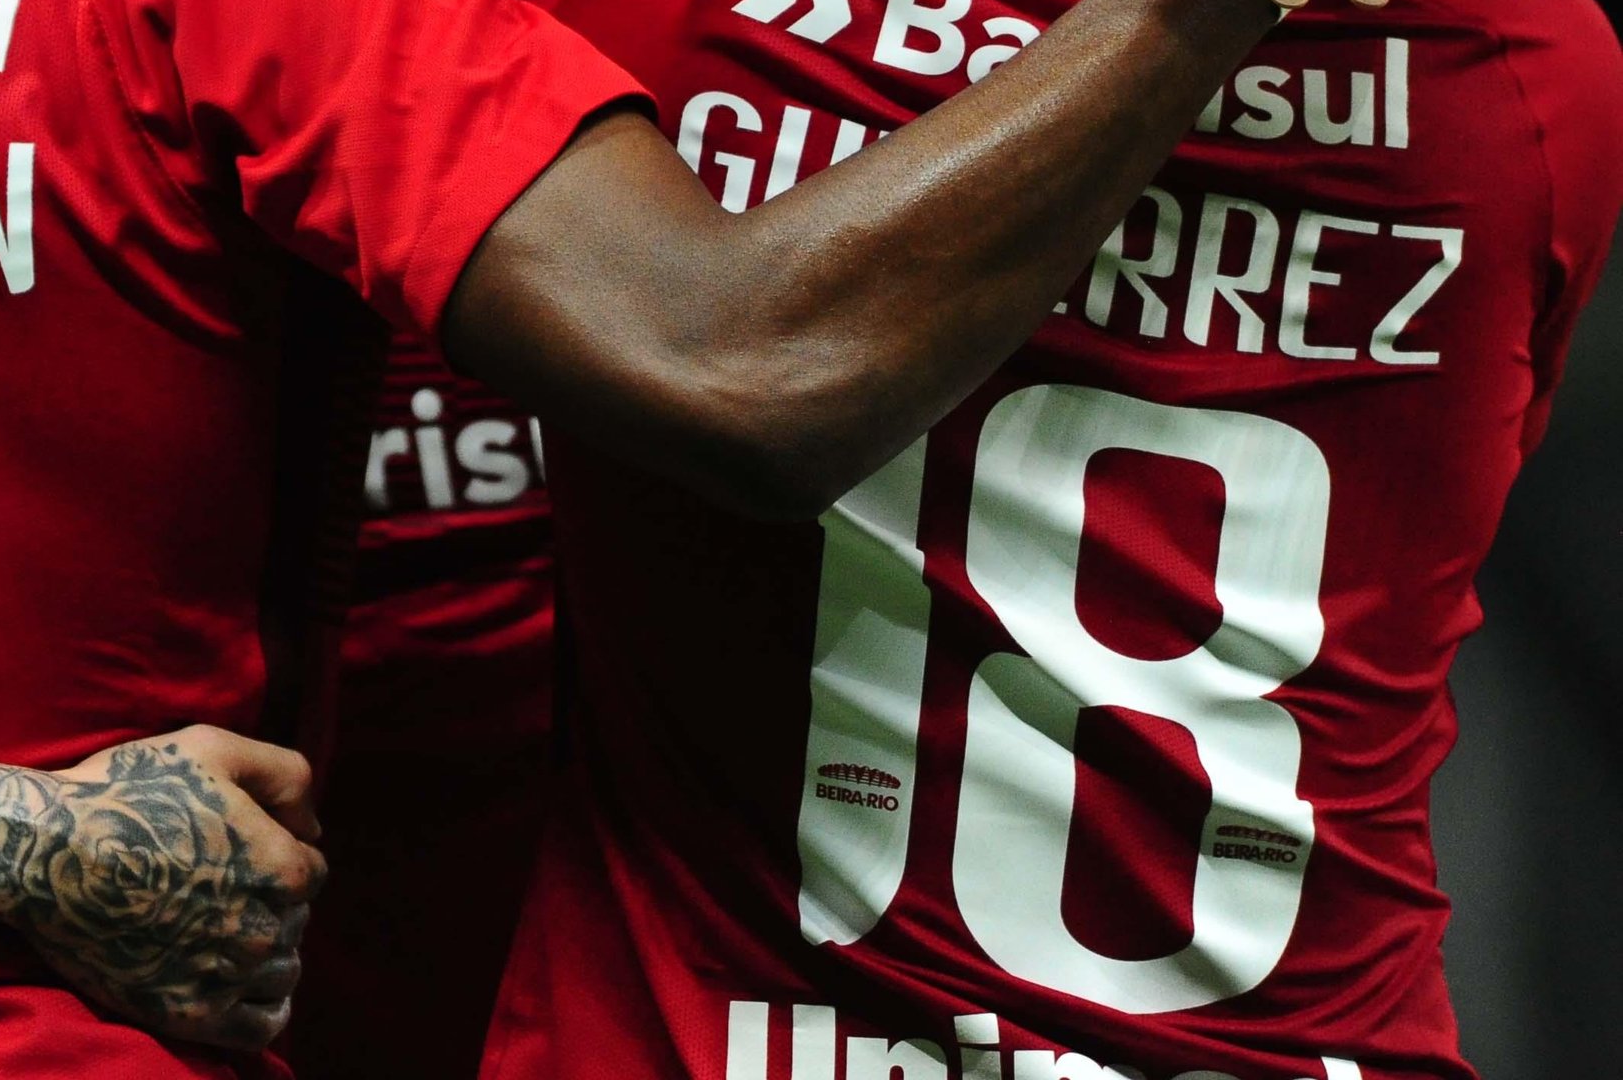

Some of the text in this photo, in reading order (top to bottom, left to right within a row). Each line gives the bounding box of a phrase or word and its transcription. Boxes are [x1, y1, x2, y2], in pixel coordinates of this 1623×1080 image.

[678, 90, 1465, 366] GURREZ
[364, 387, 546, 510] ris
[797, 383, 1332, 1015] 18
[815, 782, 900, 812] BEIRA-RIO
